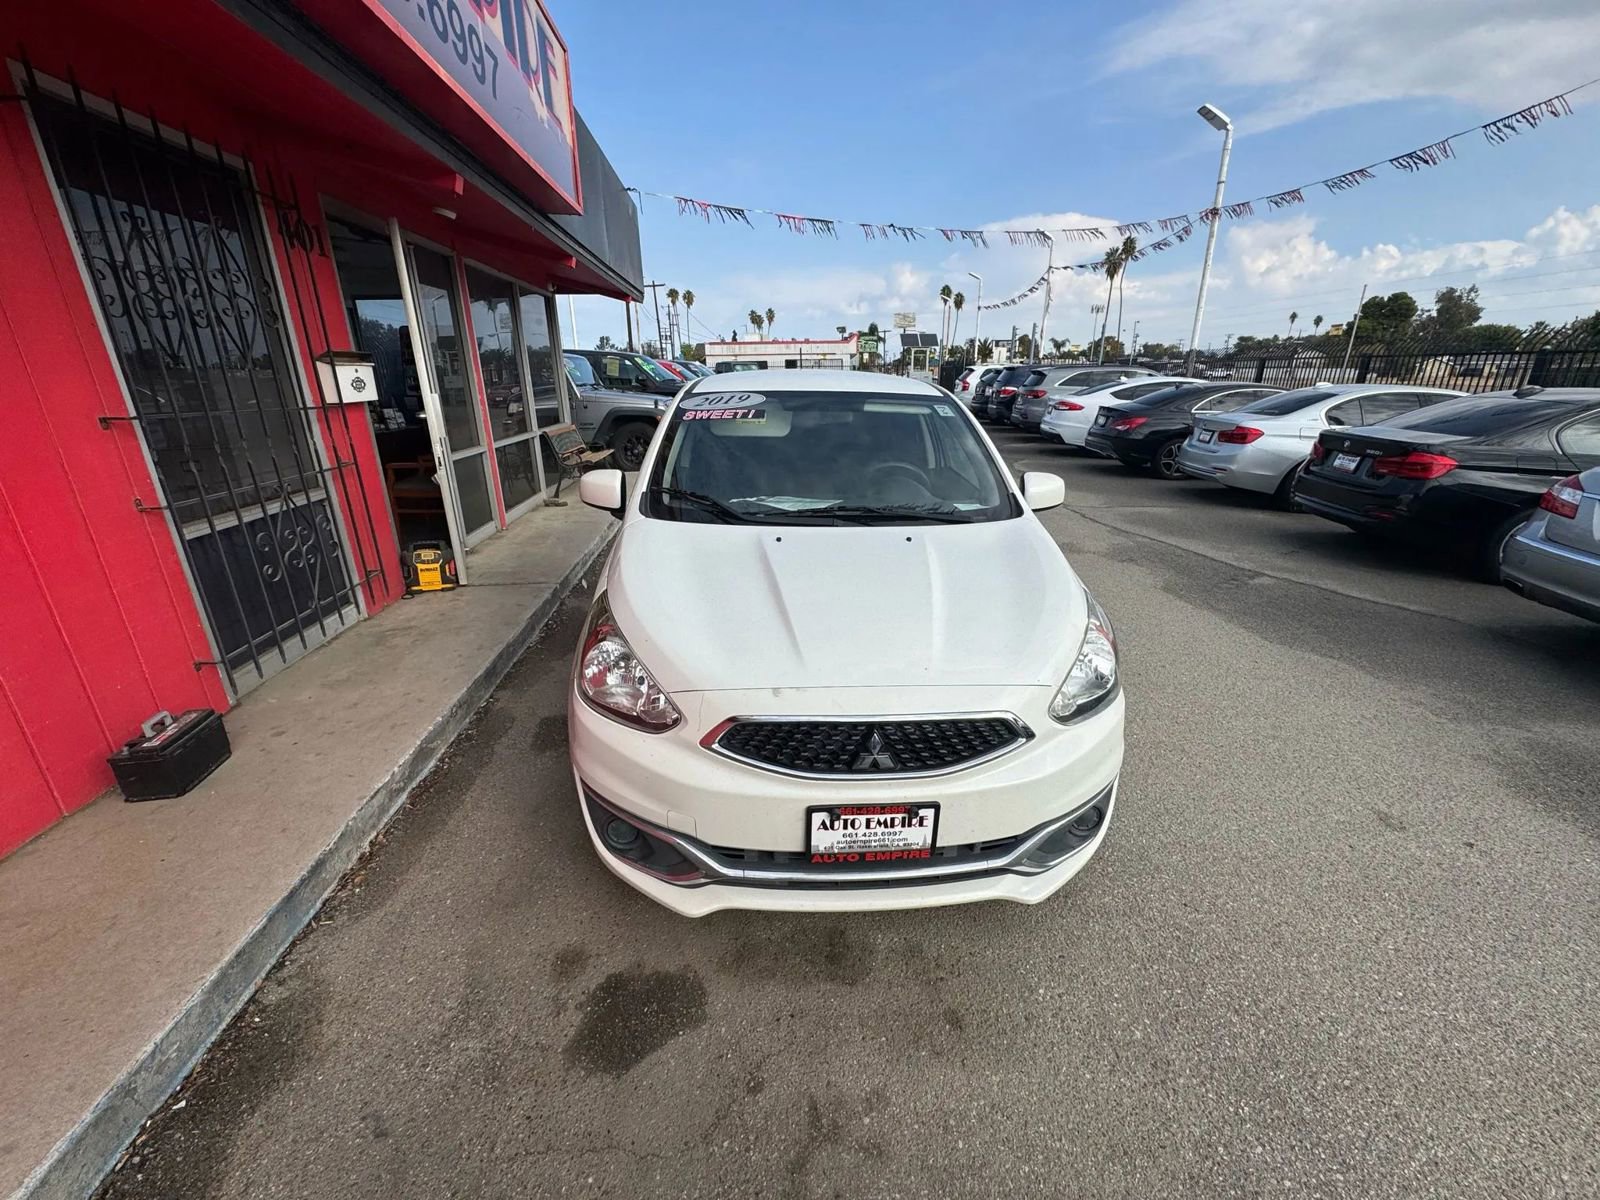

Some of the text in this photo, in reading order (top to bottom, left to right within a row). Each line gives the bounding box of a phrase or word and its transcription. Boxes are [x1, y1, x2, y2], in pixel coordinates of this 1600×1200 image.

[695, 394, 751, 406] 2019
[817, 816, 929, 831] AUTO EMPIRE
[842, 831, 903, 839] 661.428.6997
[811, 849, 931, 863] AUTO EMPIRE
